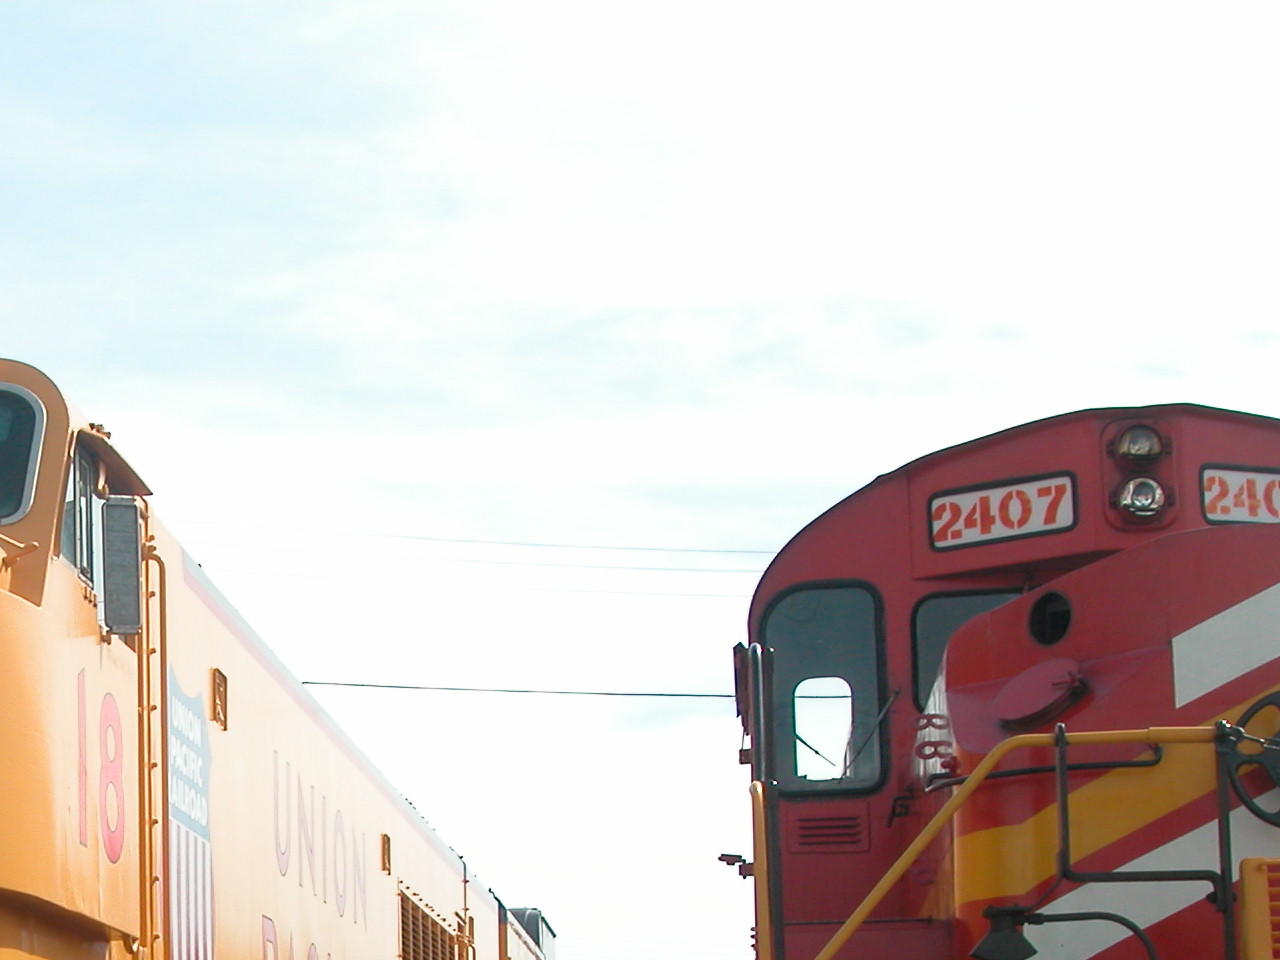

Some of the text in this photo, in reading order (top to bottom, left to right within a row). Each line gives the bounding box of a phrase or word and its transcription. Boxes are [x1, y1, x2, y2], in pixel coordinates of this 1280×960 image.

[932, 483, 1068, 544] 2407
[77, 668, 125, 864] 18
[170, 774, 208, 827] AILROAD
[273, 749, 367, 933] UNION
